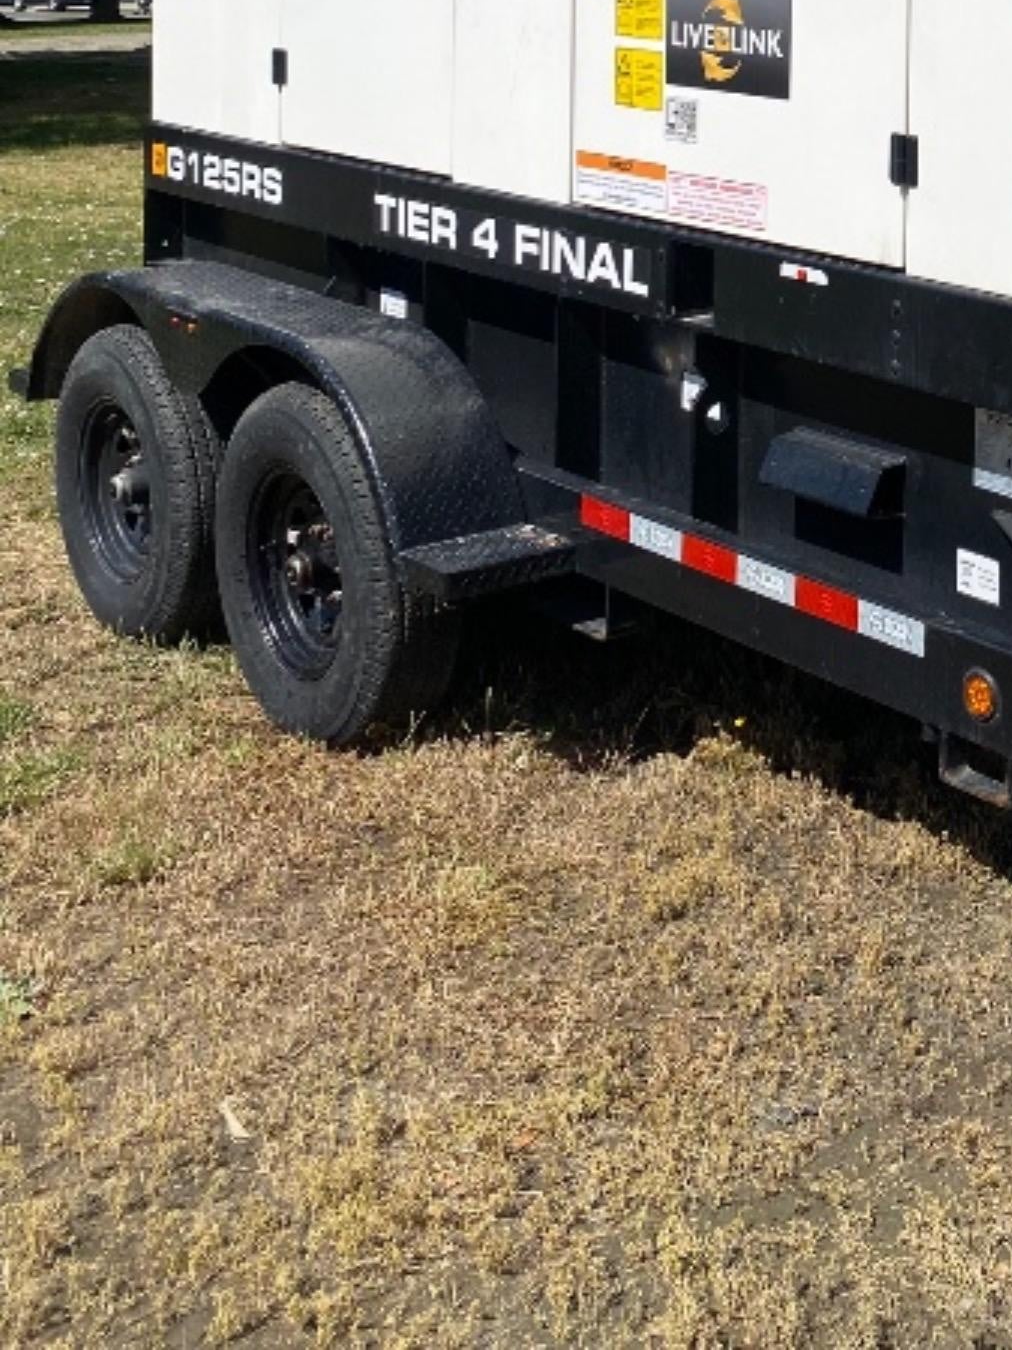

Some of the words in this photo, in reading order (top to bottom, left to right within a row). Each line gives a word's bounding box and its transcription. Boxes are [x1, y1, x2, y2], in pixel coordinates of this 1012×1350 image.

[670, 19, 715, 50] LIVE
[731, 26, 784, 58] LINK
[167, 146, 283, 205] G125RS
[374, 194, 457, 250] TIER
[471, 217, 499, 259] 4
[515, 223, 649, 298] FINAL
